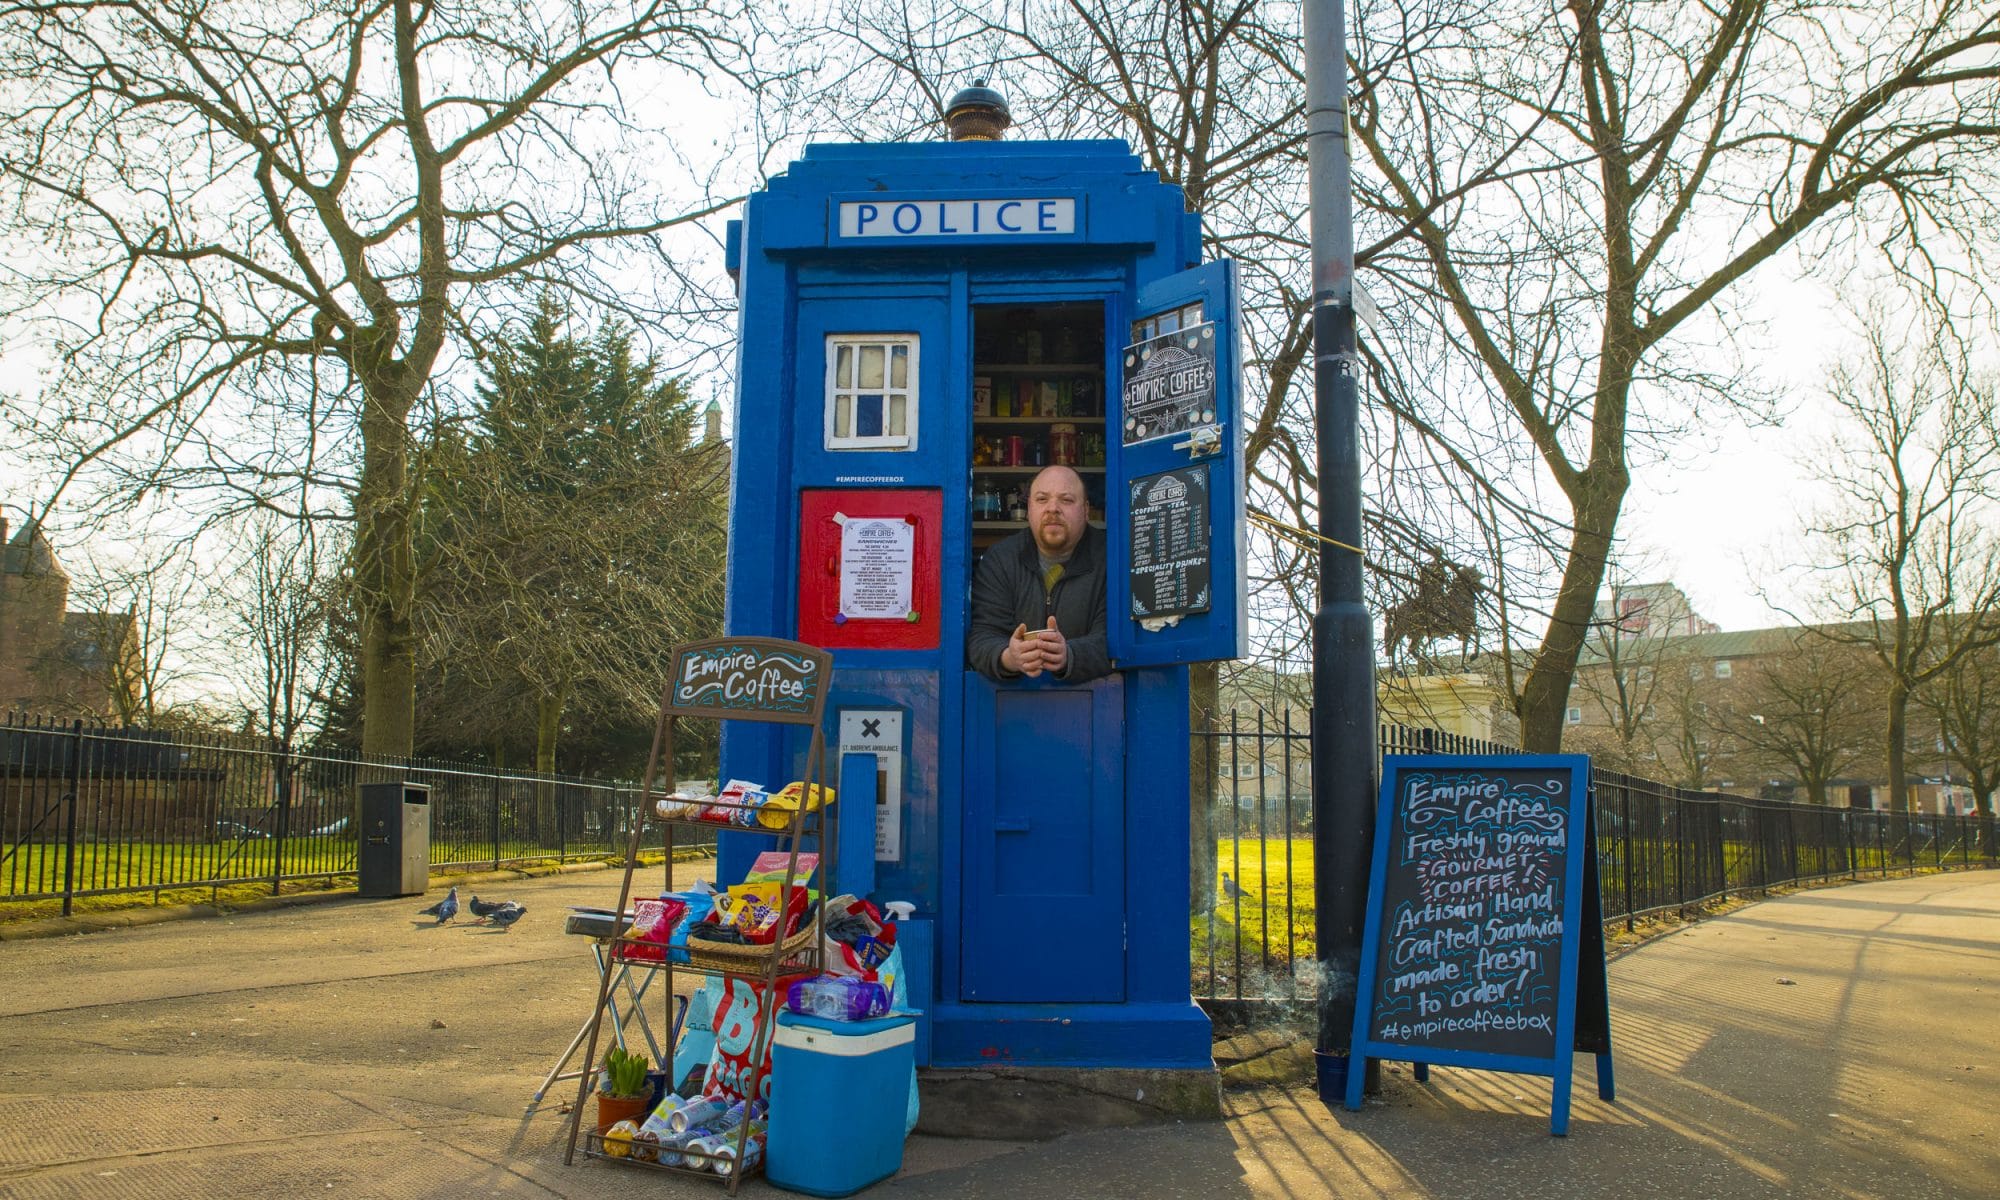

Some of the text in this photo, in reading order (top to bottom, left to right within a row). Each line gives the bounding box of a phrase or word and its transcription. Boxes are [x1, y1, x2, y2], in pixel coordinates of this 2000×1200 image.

[857, 201, 1057, 235] POLICE
[1131, 366, 1205, 406] EMPIRE COFFEE
[684, 652, 756, 682] Empire
[725, 668, 804, 702] Coffee
[1408, 780, 1499, 810] Empire
[1464, 799, 1548, 824] Coffee
[1408, 828, 1566, 859] Freshly ground
[1430, 852, 1533, 877] GOURMET
[1395, 884, 1553, 936] Artisan Hand
[1395, 924, 1480, 965] Crafted
[1394, 947, 1537, 993] made fresh
[1418, 968, 1530, 1016] to order!
[1381, 1009, 1553, 1040] #empirecoffeebox
